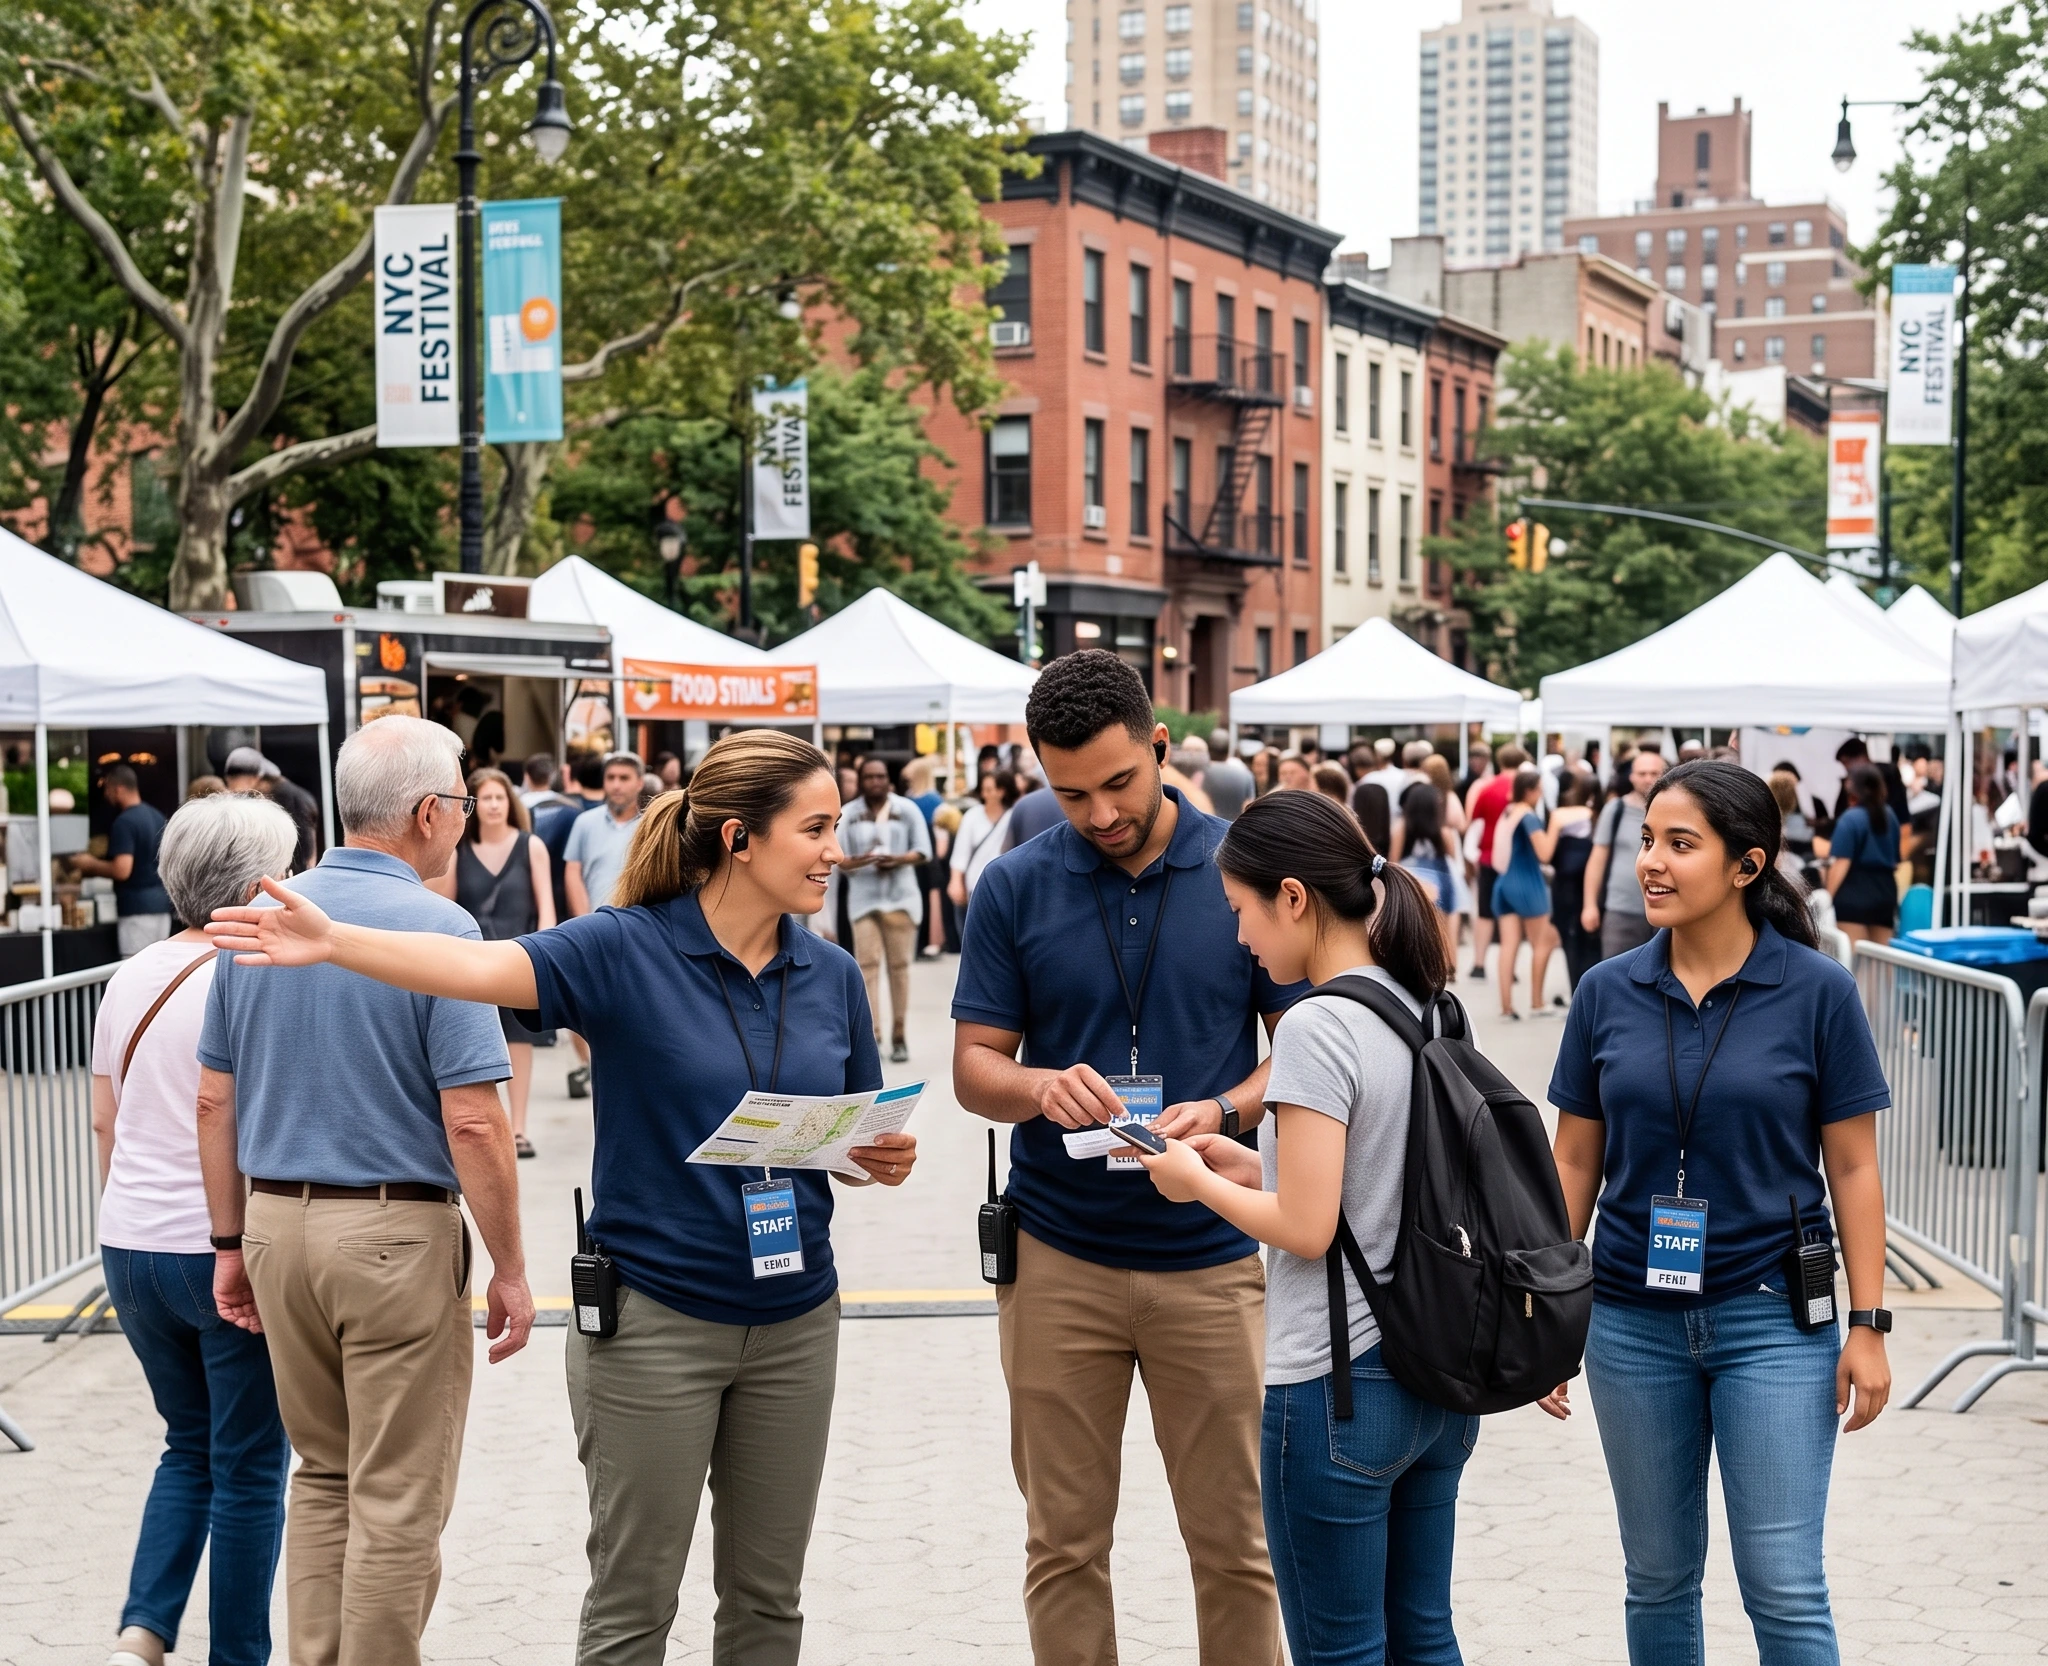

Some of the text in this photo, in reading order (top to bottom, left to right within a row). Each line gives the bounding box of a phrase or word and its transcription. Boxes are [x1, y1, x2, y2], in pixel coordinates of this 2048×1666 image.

[384, 253, 414, 334] NYC
[420, 233, 450, 402] FESTIVAL
[1899, 319, 1921, 373] NYC
[1924, 303, 1946, 405] FESTIVAL
[783, 416, 802, 507] FESTIVA
[671, 672, 717, 706] FOOD
[752, 1215, 793, 1236] STAFF
[1653, 1234, 1700, 1252] STAFF
